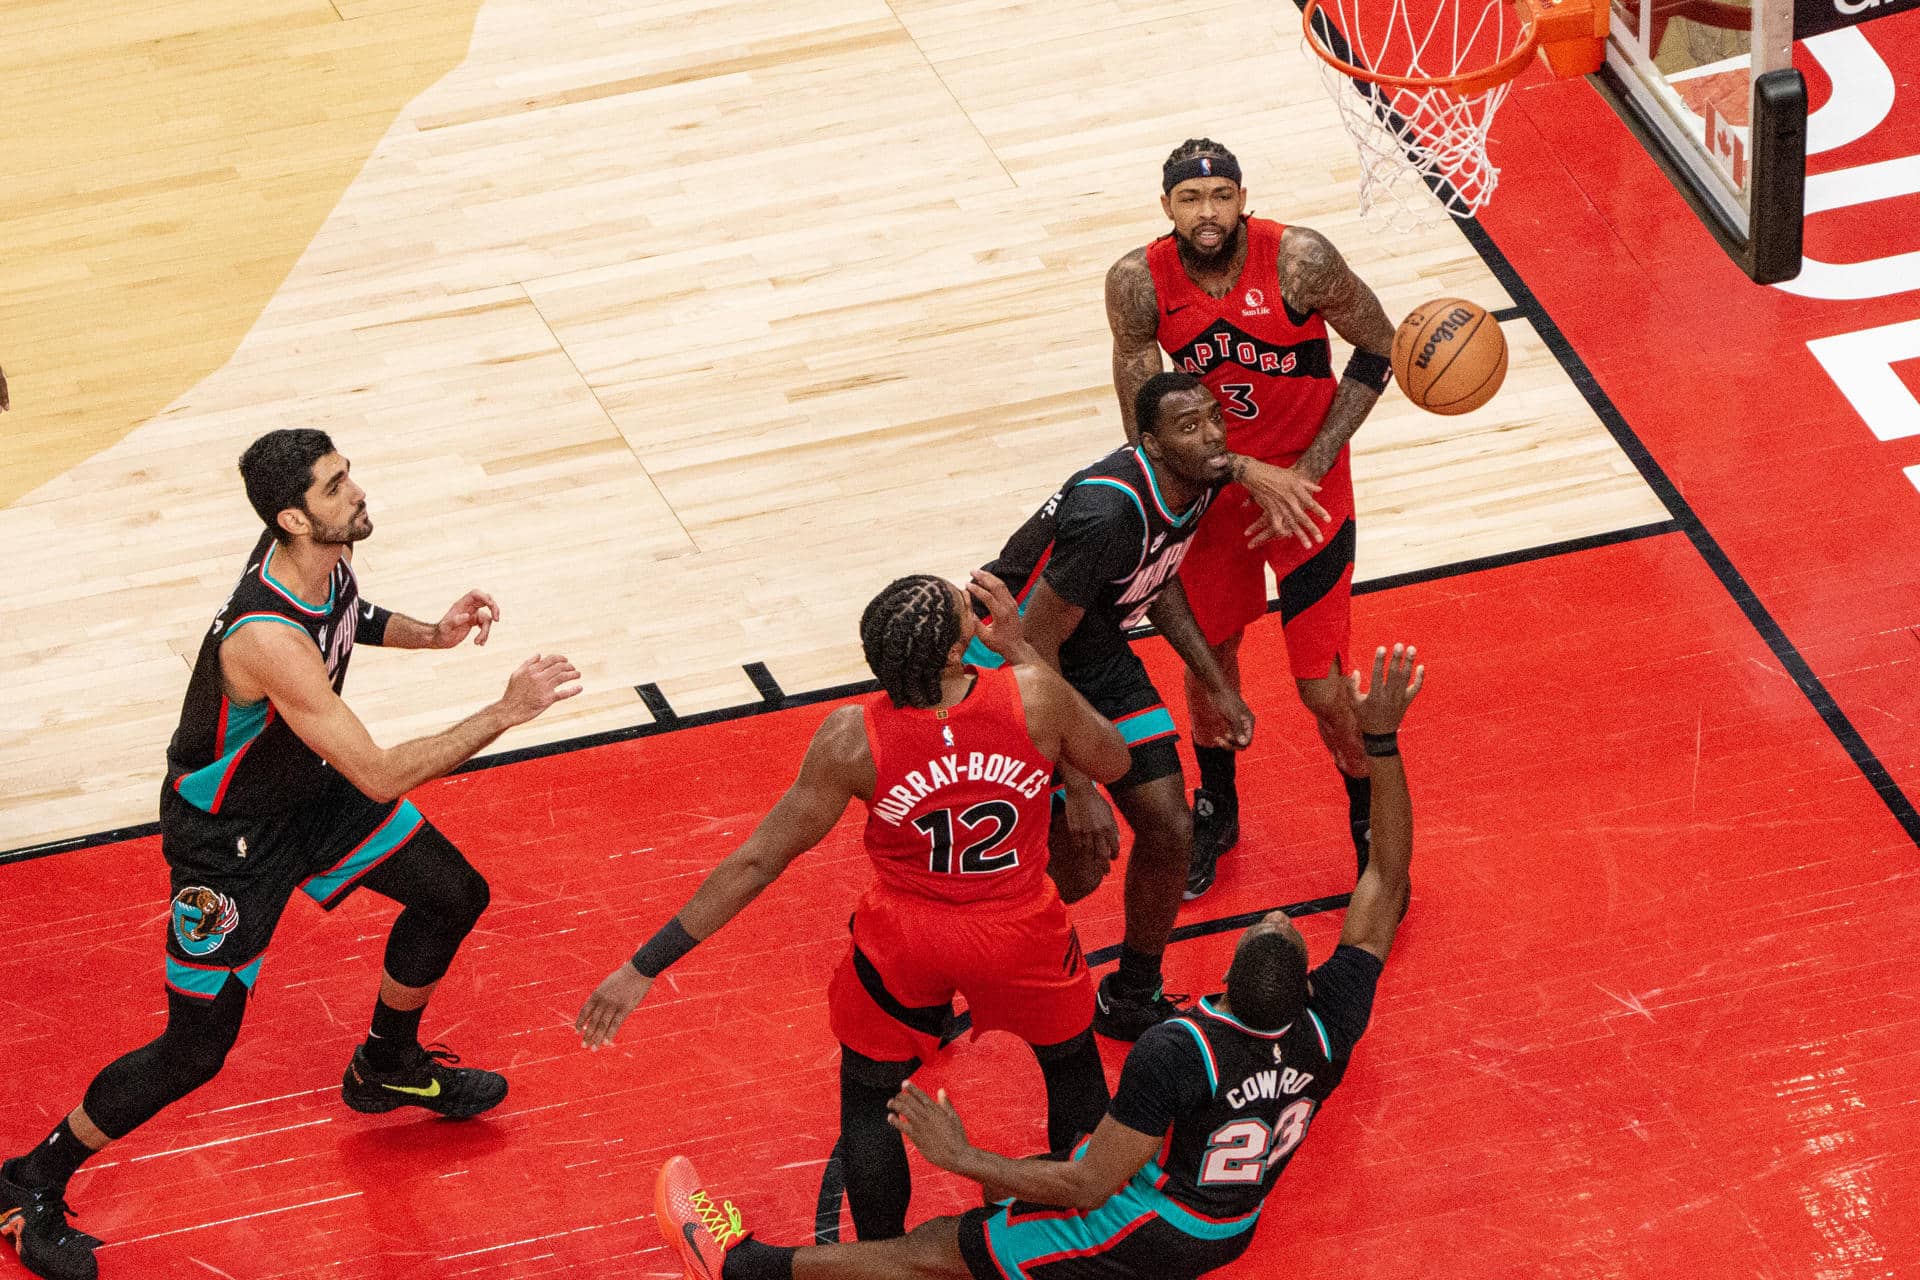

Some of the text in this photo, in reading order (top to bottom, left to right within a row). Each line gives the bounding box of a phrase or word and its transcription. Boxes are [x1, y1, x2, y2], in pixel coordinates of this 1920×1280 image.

[1257, 307, 1270, 315] Life
[1415, 308, 1474, 369] Wilson
[1221, 383, 1259, 420] 3
[872, 752, 1050, 827] MURRAY-BOYLES
[911, 799, 1019, 874] 12
[1197, 1096, 1317, 1186] 23
